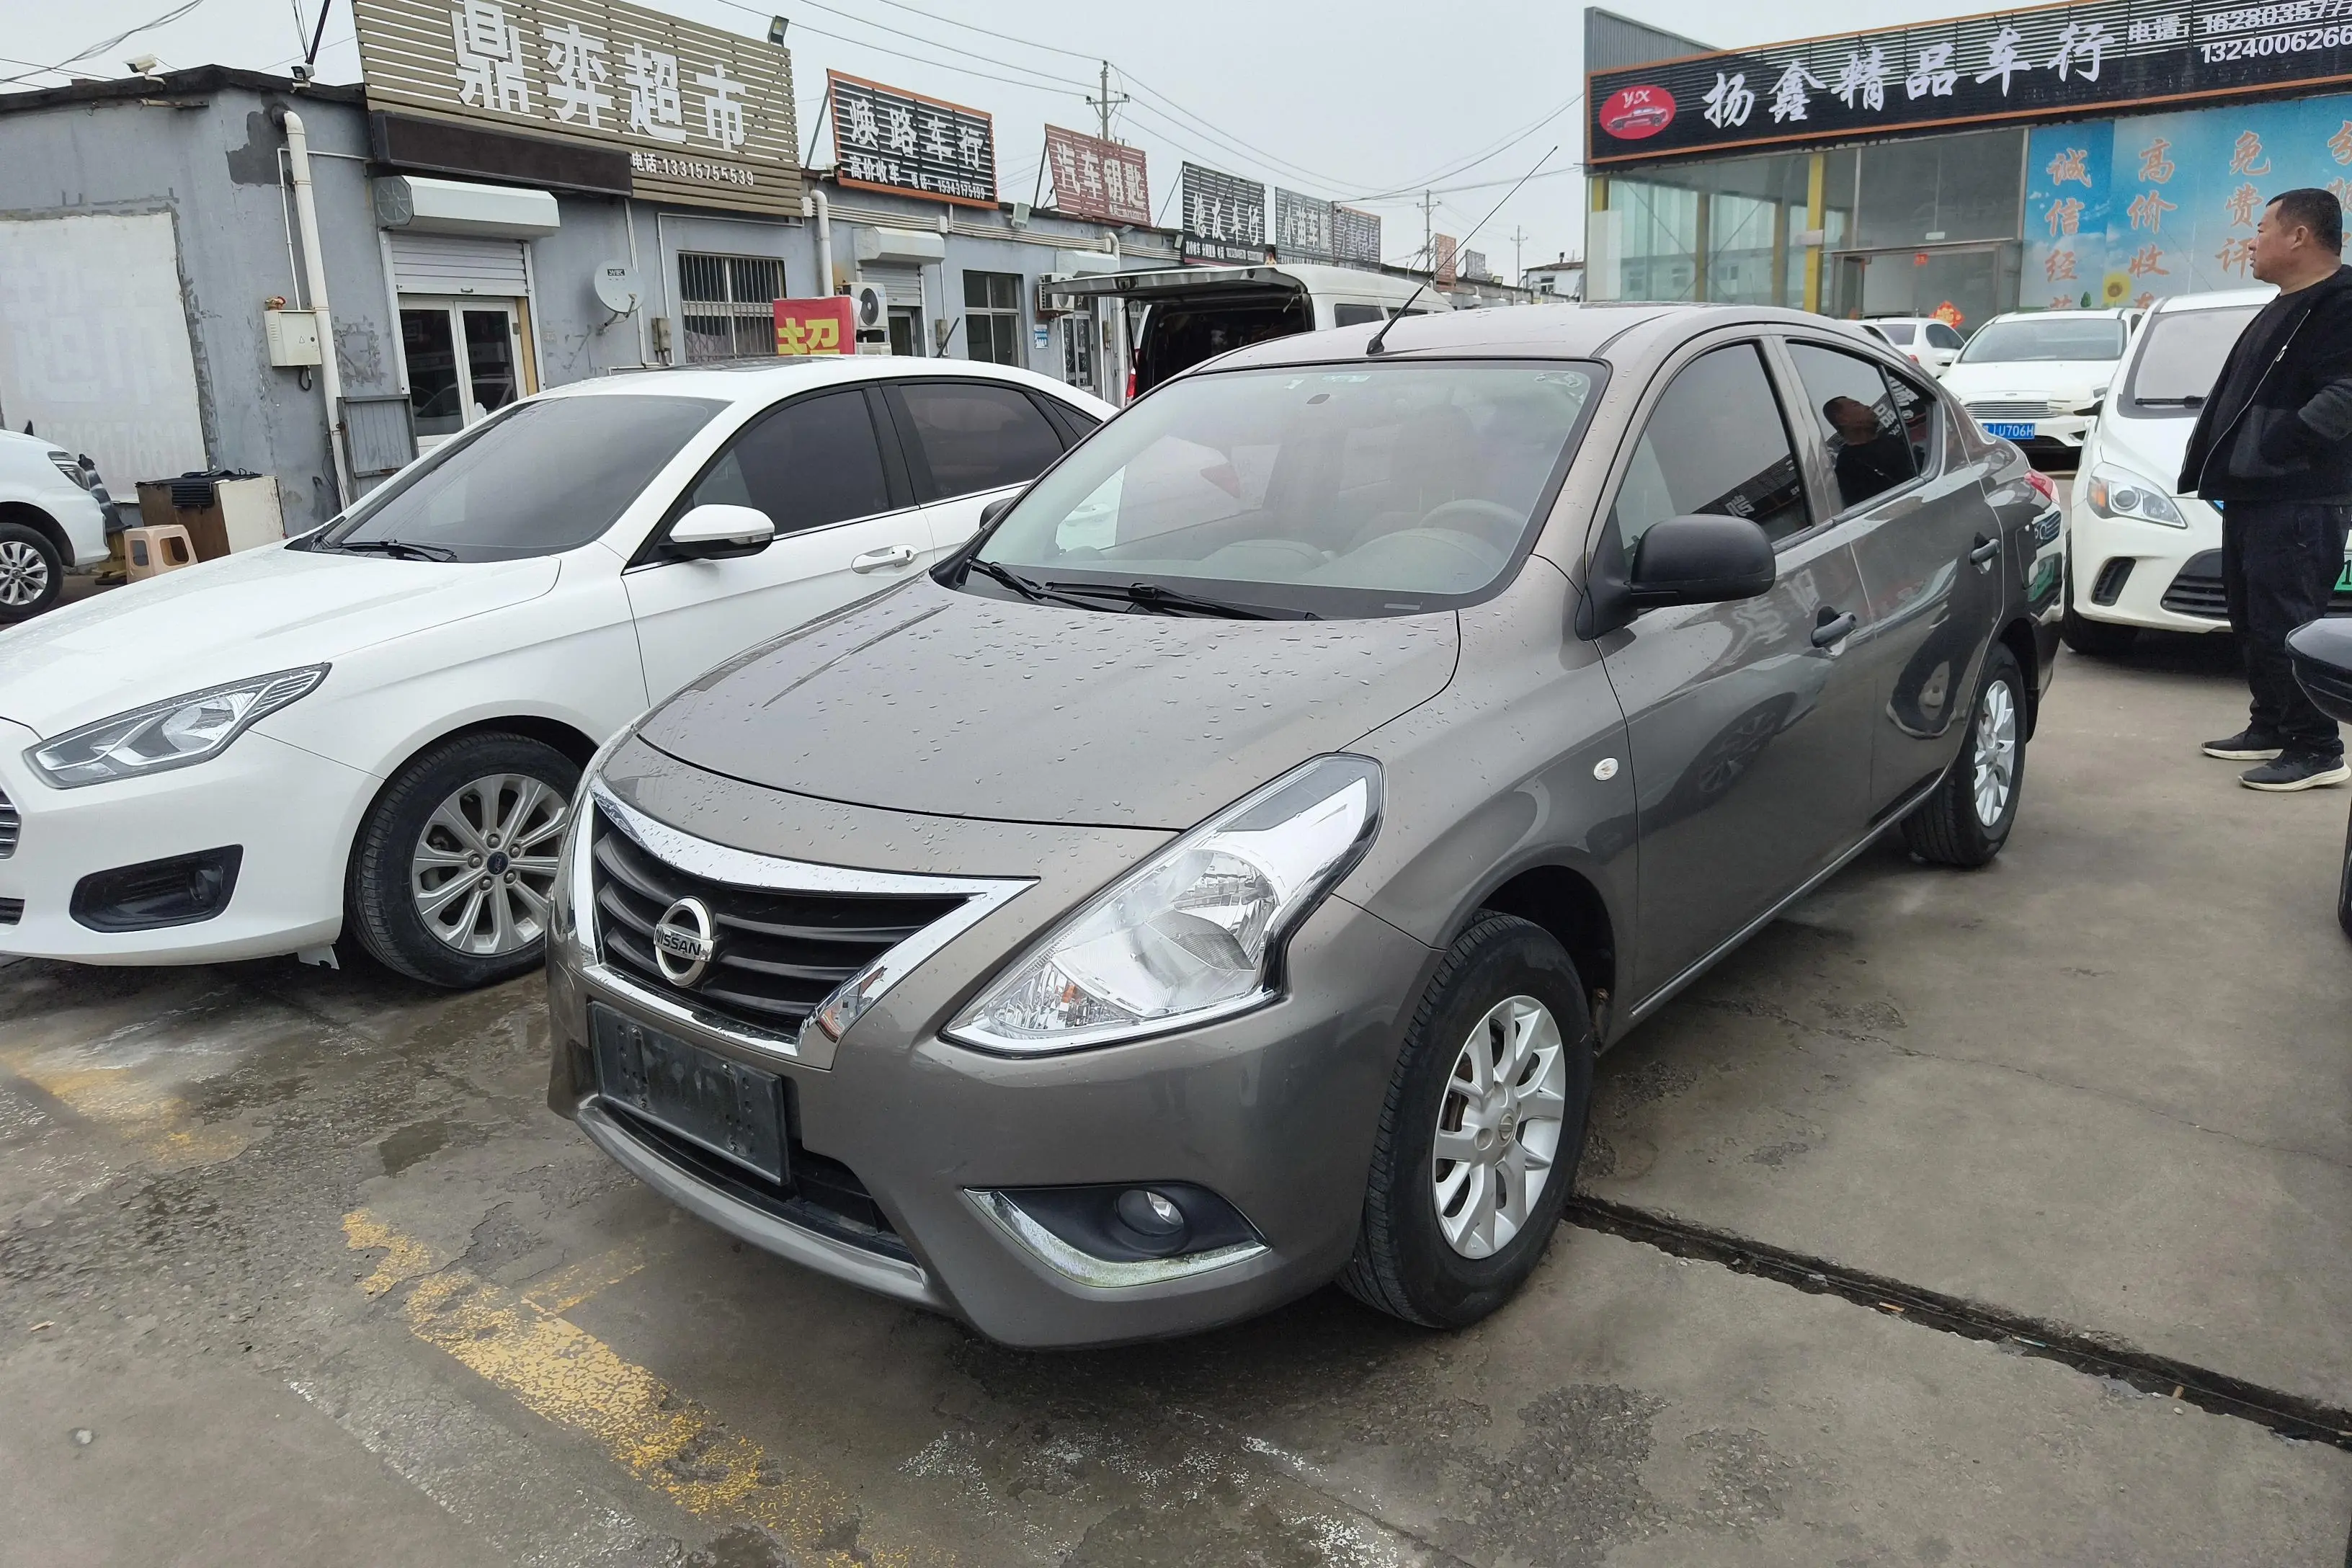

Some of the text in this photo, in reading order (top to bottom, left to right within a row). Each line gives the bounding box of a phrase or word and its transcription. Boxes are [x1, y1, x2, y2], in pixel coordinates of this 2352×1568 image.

[1702, 22, 2115, 129] 扬鑫精品车行
[849, 155, 901, 186] 高价收车
[1056, 142, 1147, 209] 汽车钥匙
[654, 927, 702, 956] NISSAN
